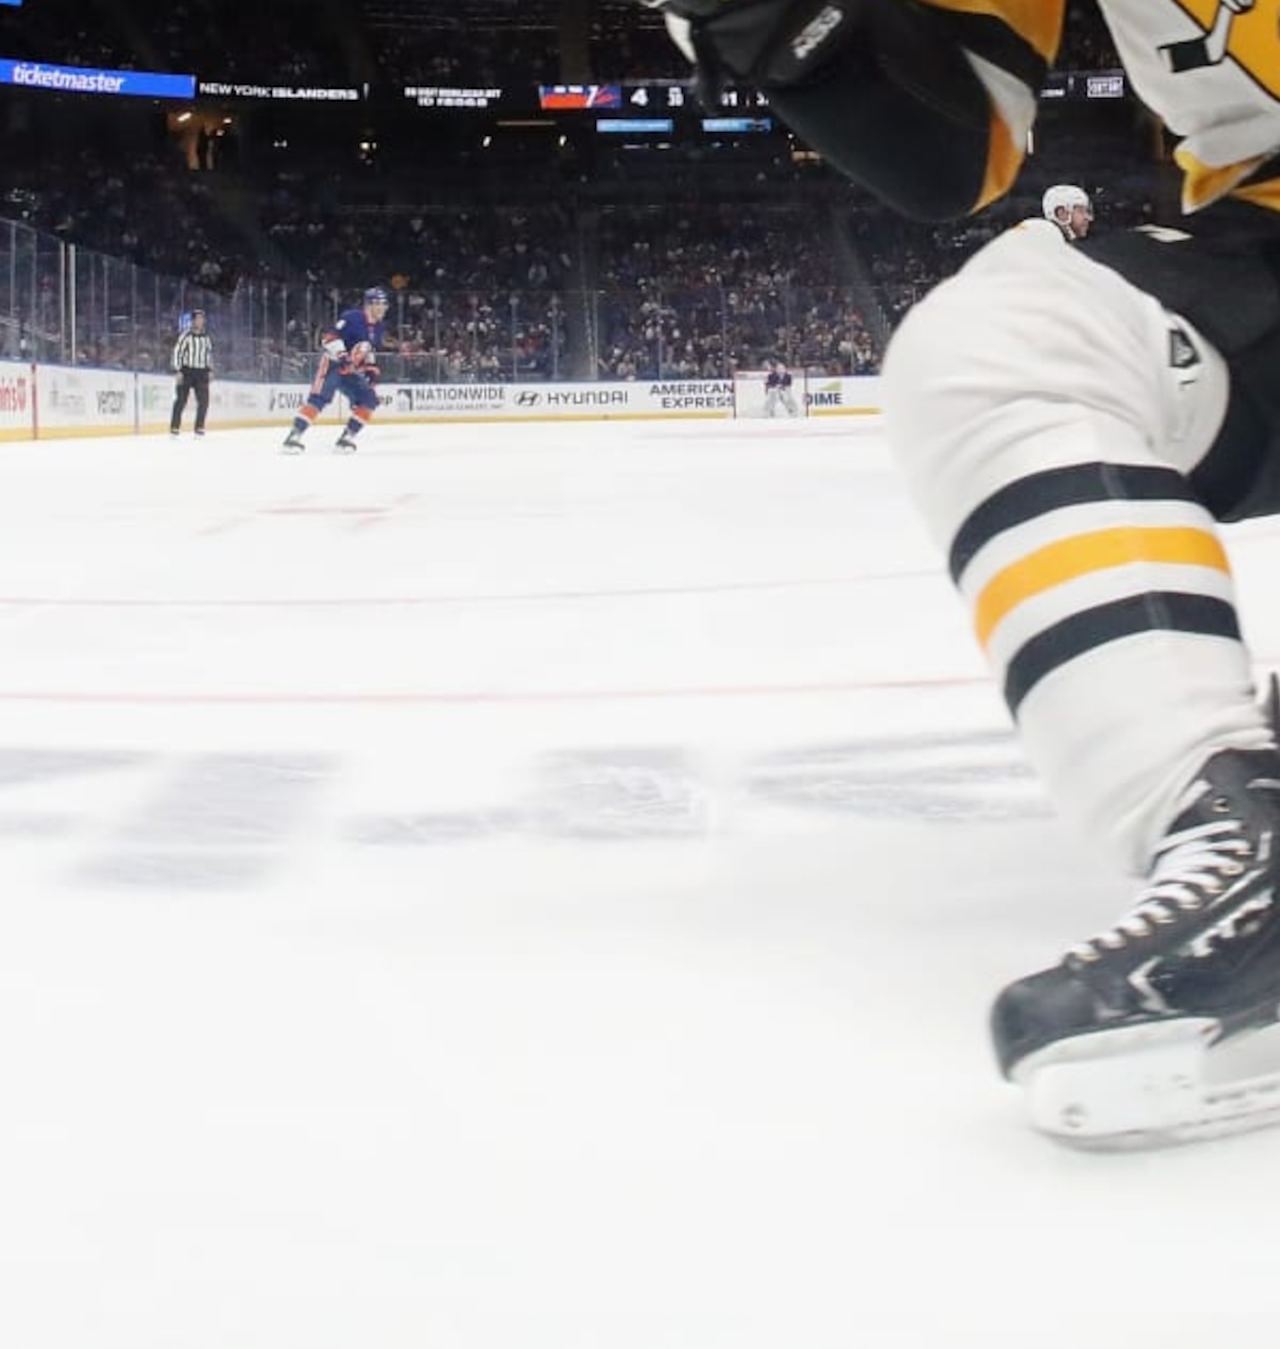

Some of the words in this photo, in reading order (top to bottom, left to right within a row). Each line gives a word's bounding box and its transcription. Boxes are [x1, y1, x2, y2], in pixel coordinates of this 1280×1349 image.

[13, 62, 125, 94] ticketmaster
[199, 82, 232, 95] NEW
[233, 84, 271, 98] YORK
[271, 86, 359, 101] ISLANDERS
[416, 387, 506, 400] NATIONWIDE
[649, 382, 735, 396] AMERICAN
[547, 391, 629, 405] HYUNDAI
[661, 396, 735, 409] EXPRESS
